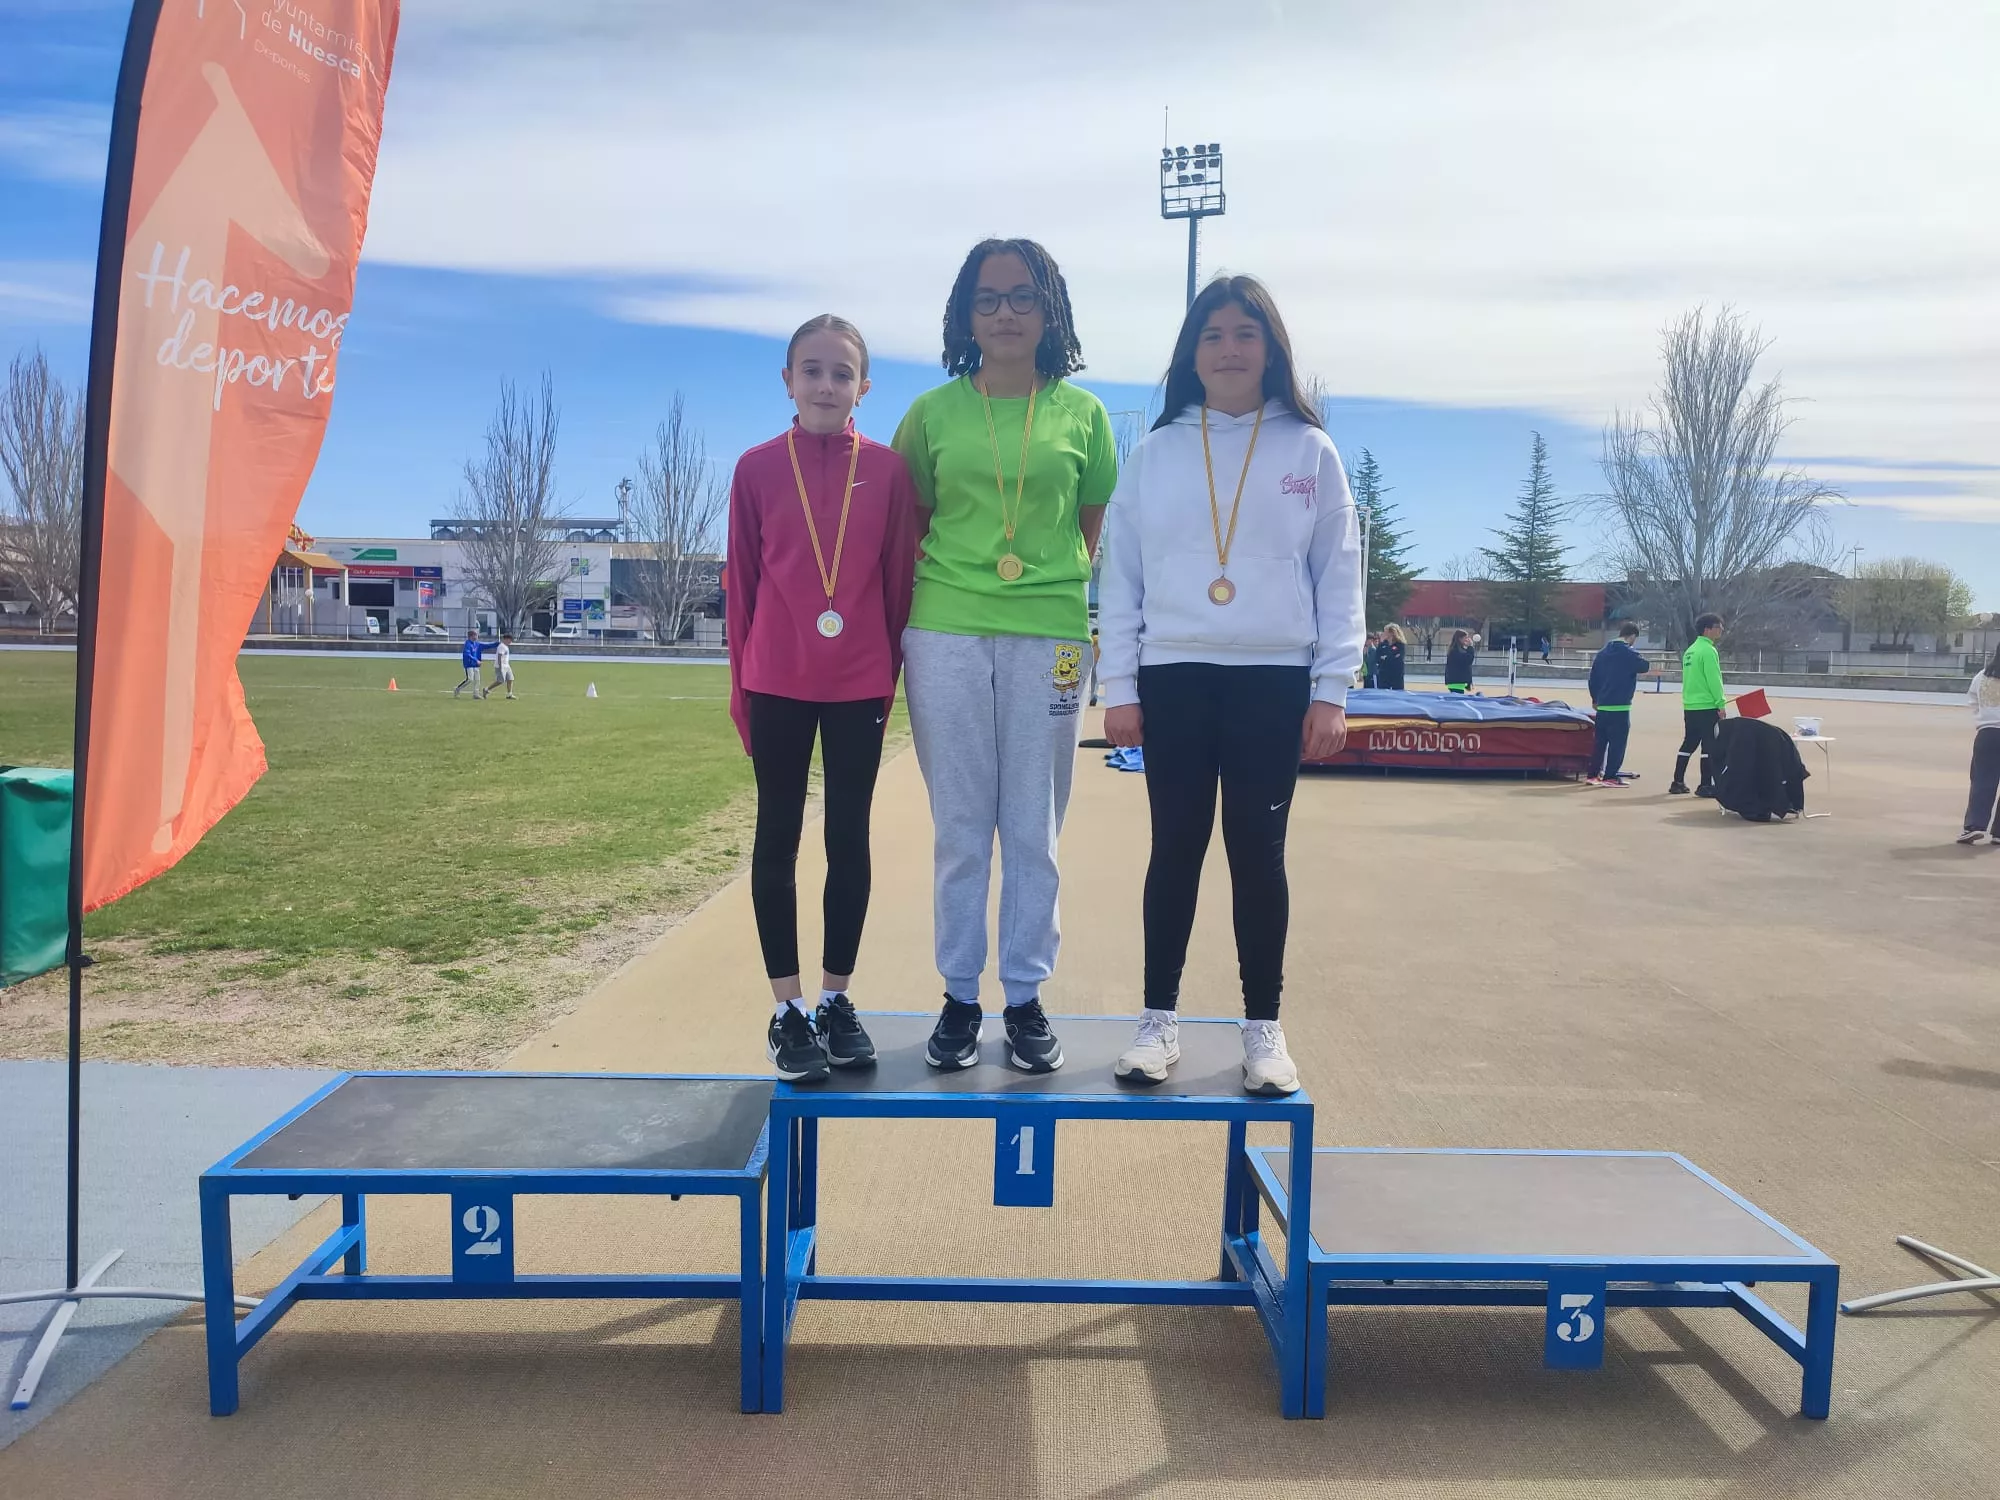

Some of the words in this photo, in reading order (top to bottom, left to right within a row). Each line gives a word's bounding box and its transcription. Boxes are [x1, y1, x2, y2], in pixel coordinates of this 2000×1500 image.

[254, 39, 312, 84] Deportes
[261, 9, 282, 34] de
[288, 23, 362, 79] Huesca
[156, 308, 336, 411] deporte
[1369, 730, 1481, 753] MONDO
[1010, 1126, 1035, 1175] 1
[463, 1206, 501, 1255] 2
[1556, 1294, 1595, 1342] 3
